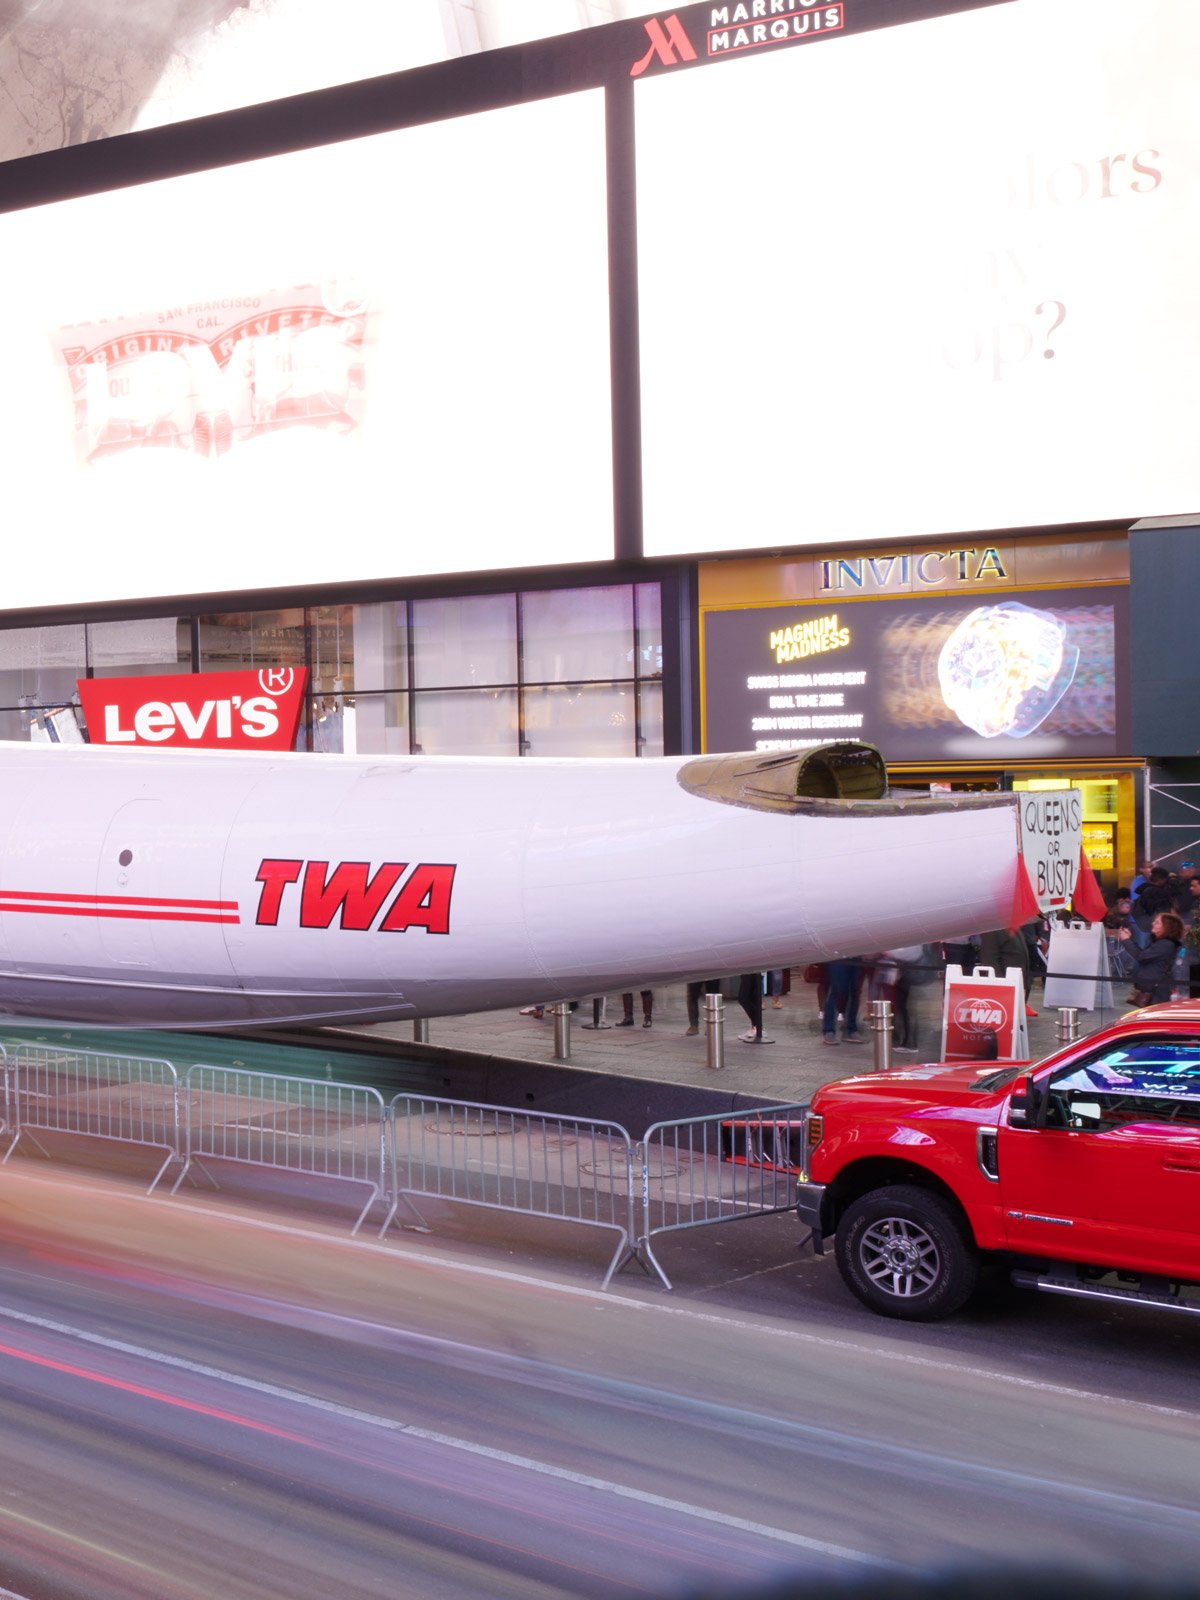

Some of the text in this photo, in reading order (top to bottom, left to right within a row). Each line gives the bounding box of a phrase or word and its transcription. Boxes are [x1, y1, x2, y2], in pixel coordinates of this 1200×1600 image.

[711, 0, 832, 27] MARRI
[711, 8, 839, 51] MARQUIS
[156, 297, 261, 325] SAN FRANCISCO
[820, 547, 1008, 590] INVICTA
[770, 614, 838, 650] MAGNUM
[777, 628, 849, 663] MADNESS
[1025, 799, 1080, 836] QUEENS
[1048, 841, 1060, 856] OR
[1038, 859, 1073, 897] BUST!
[255, 858, 457, 935] TWA
[958, 1007, 1003, 1024] TWA
